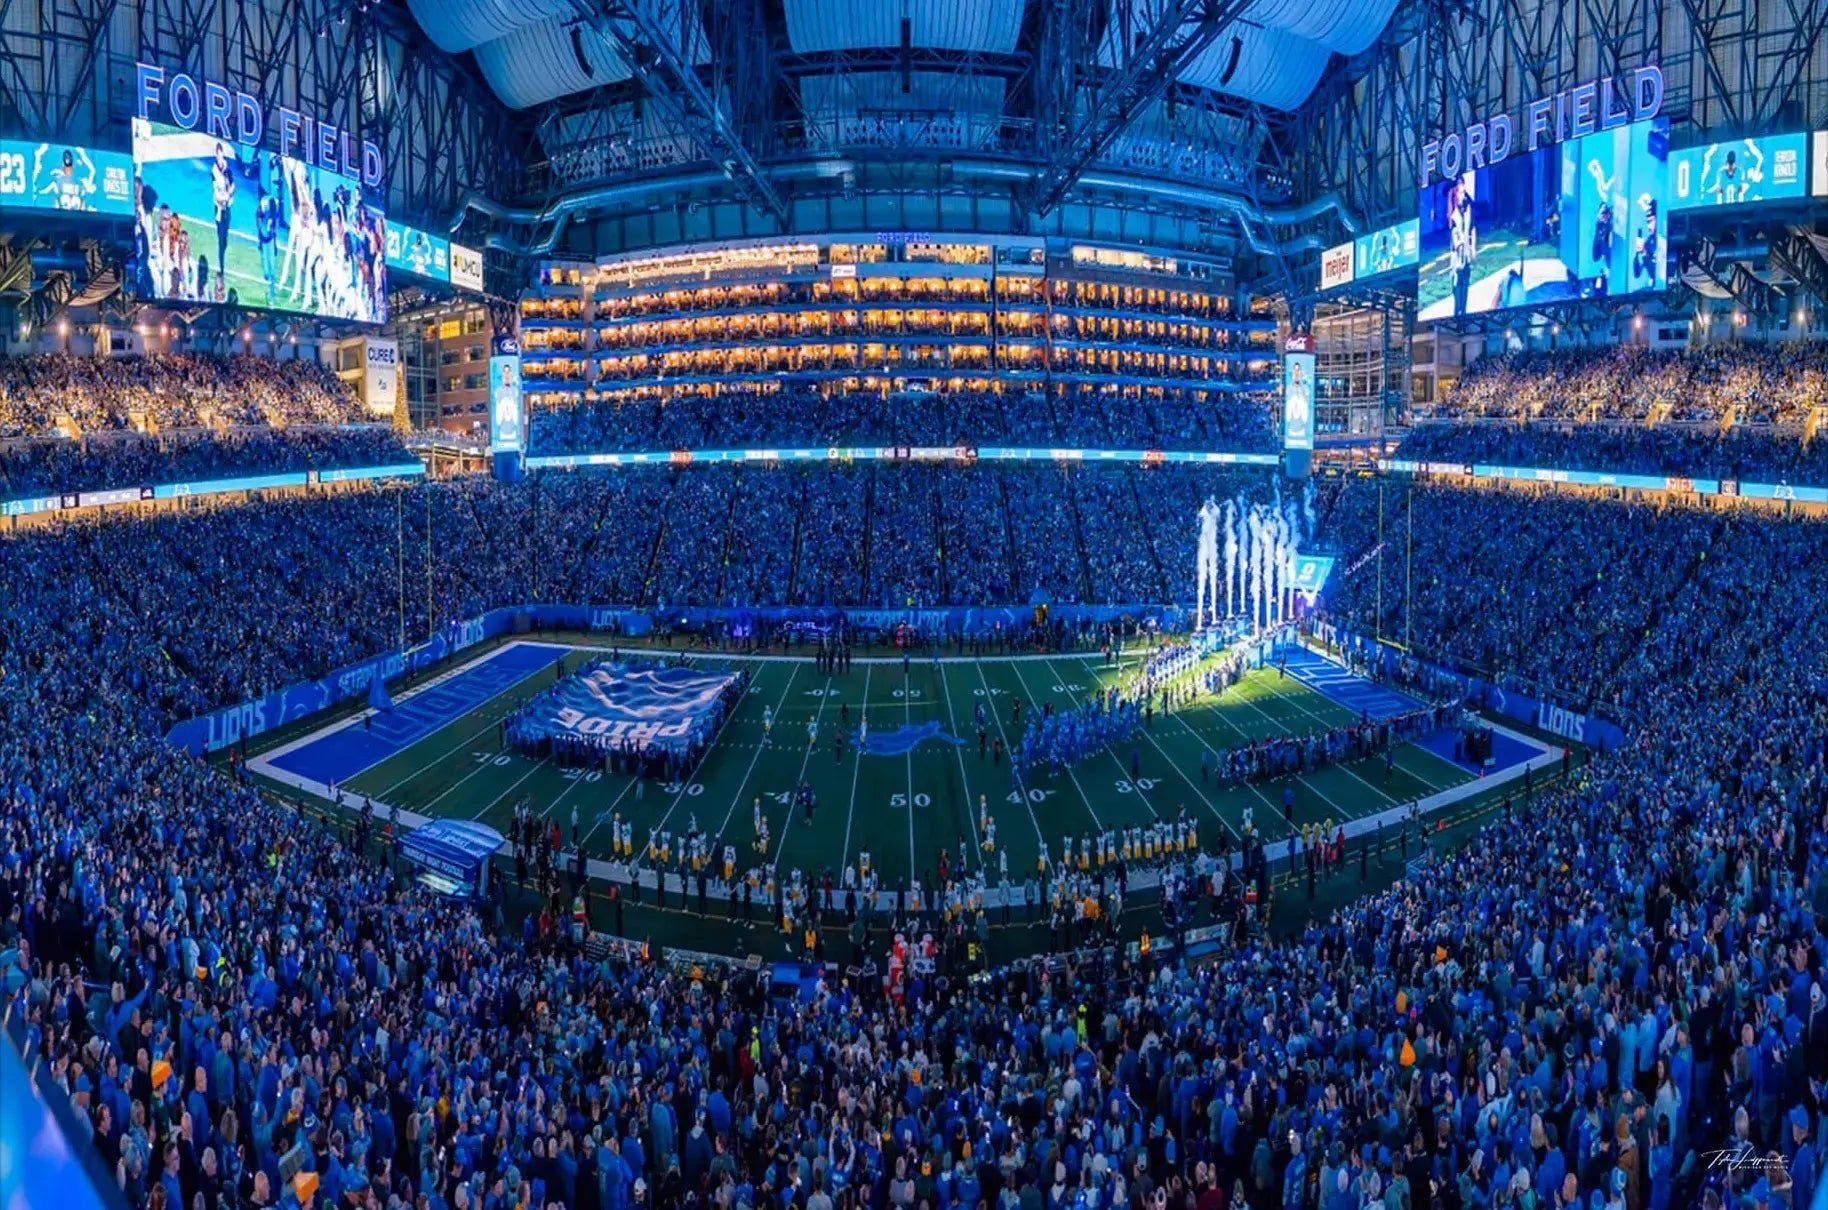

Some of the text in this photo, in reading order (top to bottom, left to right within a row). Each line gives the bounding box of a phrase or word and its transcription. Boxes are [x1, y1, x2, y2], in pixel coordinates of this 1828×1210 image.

[136, 62, 383, 187] FORD FIELD
[1422, 65, 1665, 188] FORD FIELD
[0, 152, 26, 194] 23
[1678, 160, 1690, 198] 0
[876, 232, 931, 242] FORD FIELD
[1325, 253, 1348, 278] meijer
[207, 696, 266, 752] LIONS
[550, 706, 694, 737] PRIDE
[1538, 703, 1586, 742] LIONS
[890, 793, 931, 808] 50
[1006, 789, 1046, 804] 40
[1115, 777, 1154, 794] 30
